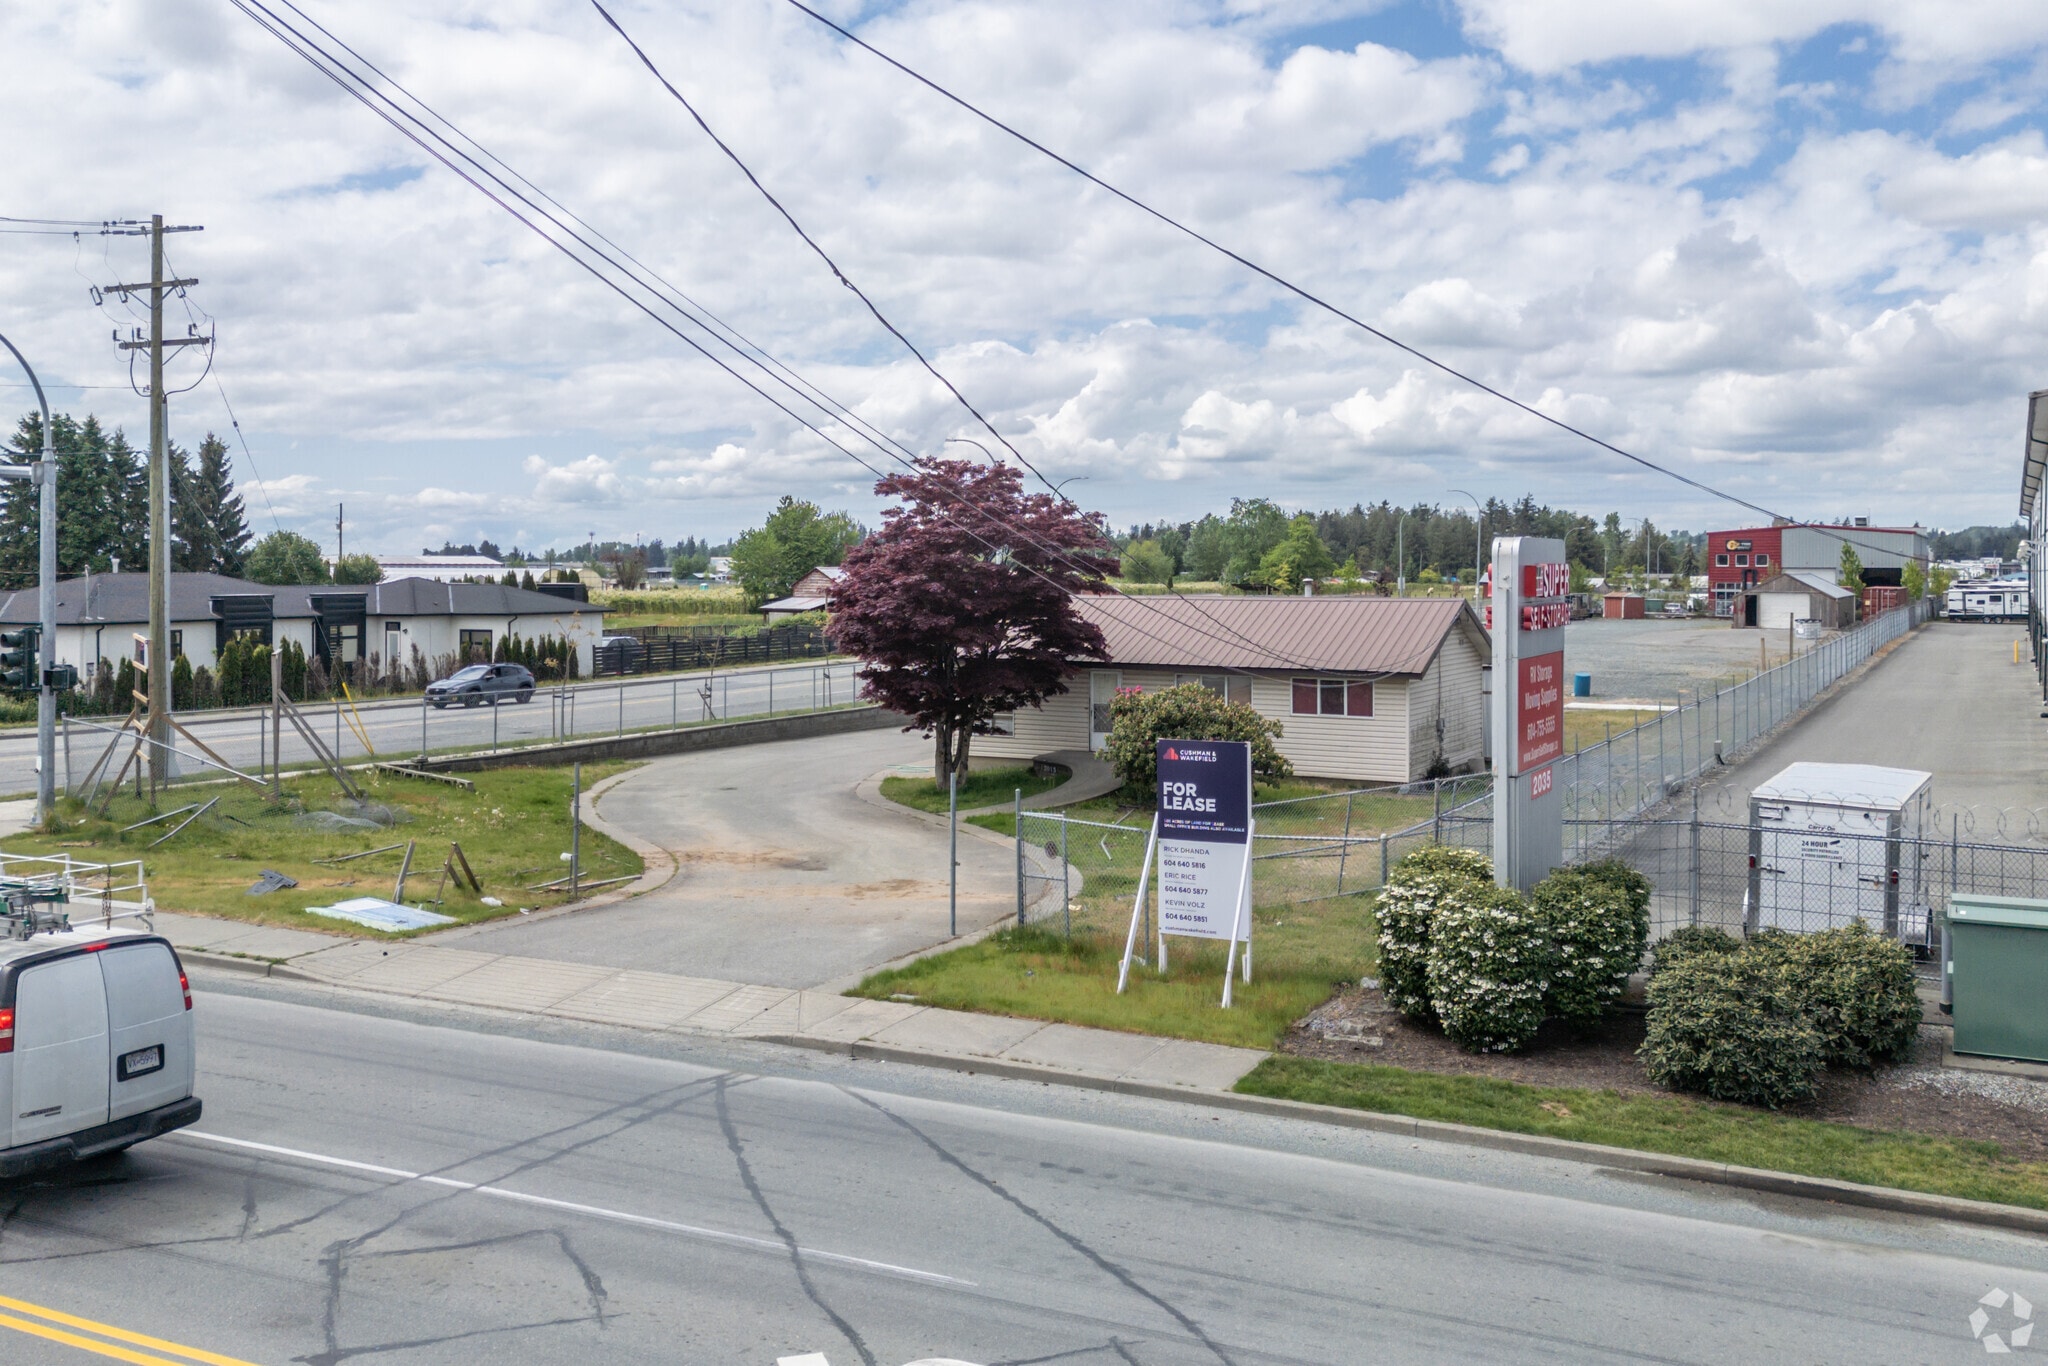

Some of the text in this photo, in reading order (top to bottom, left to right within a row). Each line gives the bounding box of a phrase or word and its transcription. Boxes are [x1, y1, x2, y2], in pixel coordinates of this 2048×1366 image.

[1543, 564, 1570, 598] SUPER
[1530, 604, 1570, 630] SELF-STORAGE
[1163, 782, 1197, 797] FOR
[1533, 770, 1551, 796] 2035
[1163, 796, 1216, 812] LEASE
